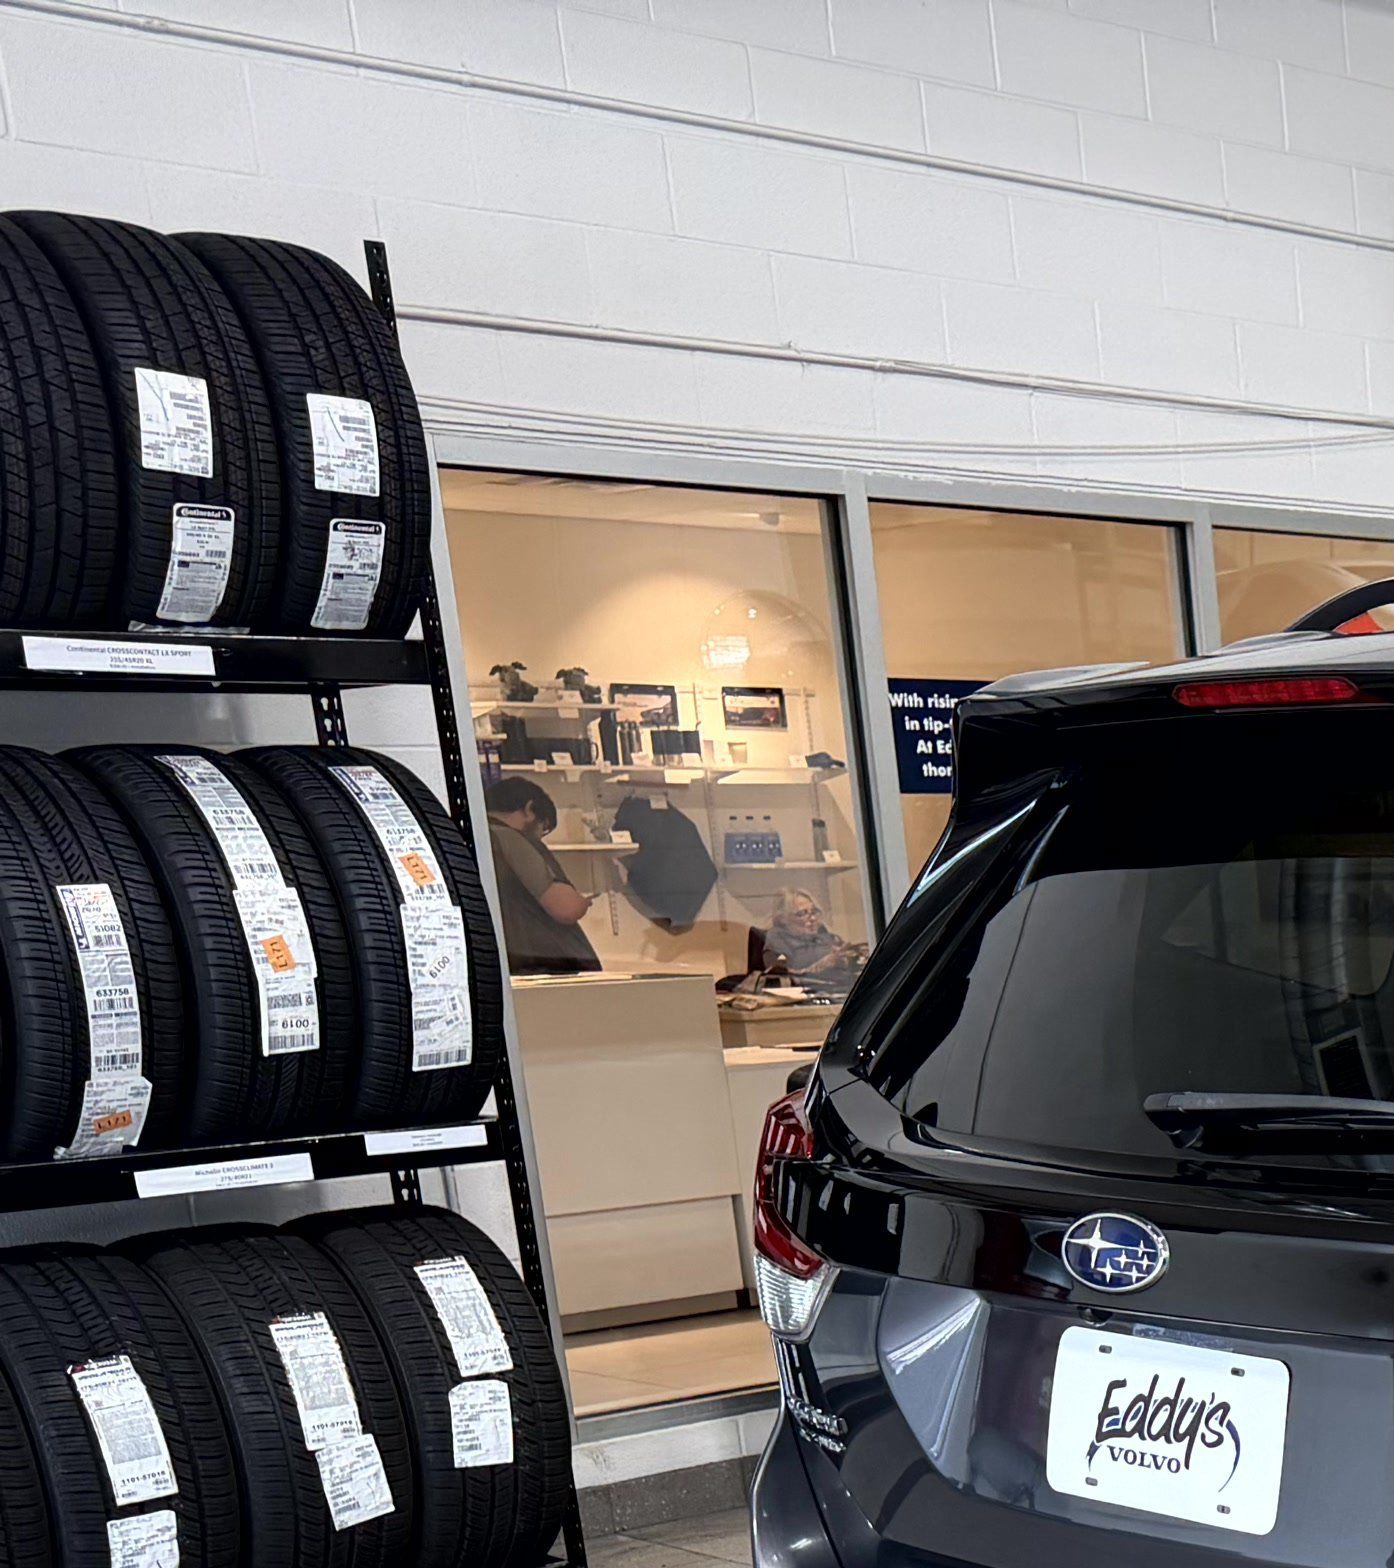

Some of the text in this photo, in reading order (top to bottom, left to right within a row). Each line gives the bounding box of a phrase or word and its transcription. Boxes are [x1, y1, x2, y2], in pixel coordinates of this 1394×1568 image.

[66, 644, 107, 655] Continental
[888, 693, 924, 708] With
[904, 716, 921, 731] in
[916, 739, 933, 755] At
[1095, 1374, 1231, 1470] Eddy's
[1107, 1445, 1181, 1474] VOLVO
